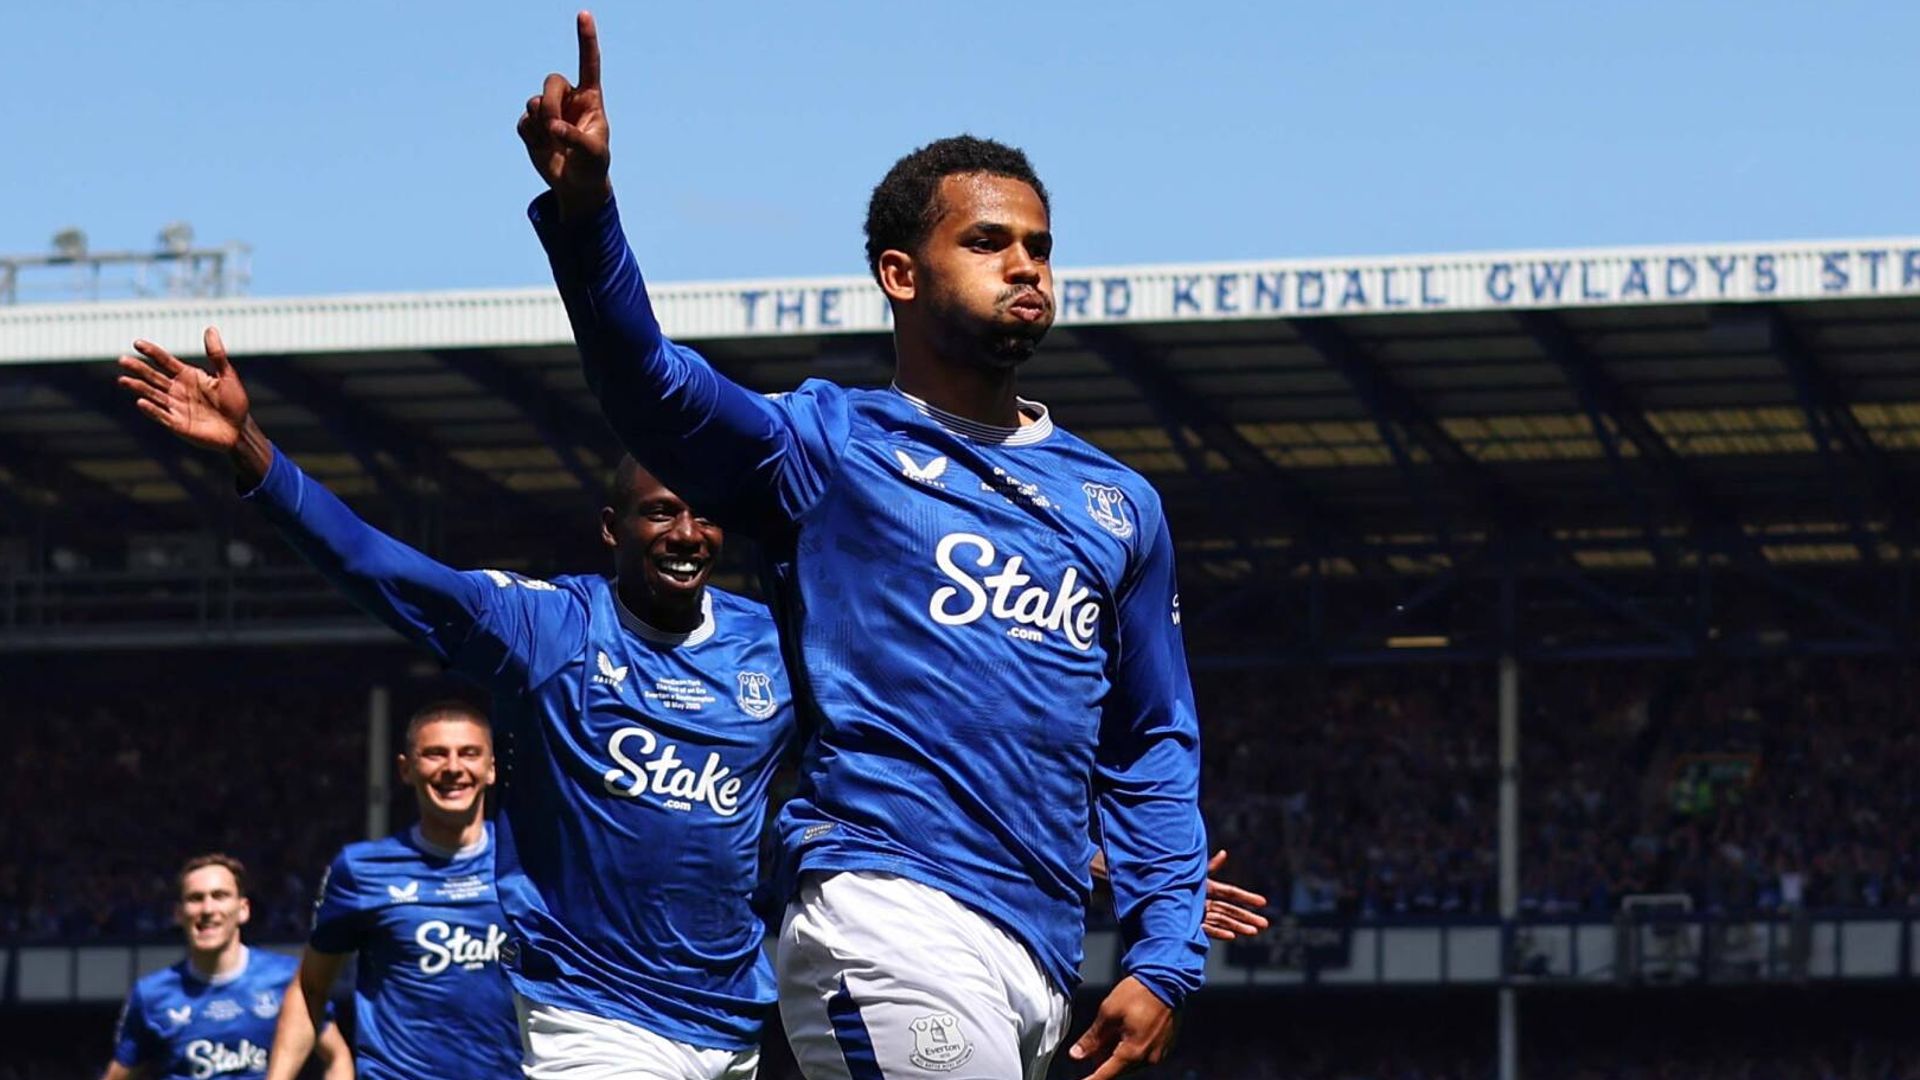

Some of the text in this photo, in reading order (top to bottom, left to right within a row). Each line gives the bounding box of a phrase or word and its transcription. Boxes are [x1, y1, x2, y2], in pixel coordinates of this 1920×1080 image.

[740, 288, 842, 327] THE
[1172, 265, 1447, 314] KENDALL
[1486, 254, 1777, 301] GWLADYS
[929, 533, 1100, 650] Stake
[1007, 626, 1044, 642] .com
[604, 727, 741, 816] Stake
[663, 800, 691, 811] .com
[415, 921, 507, 975] Stak
[187, 1039, 267, 1080] Stake
